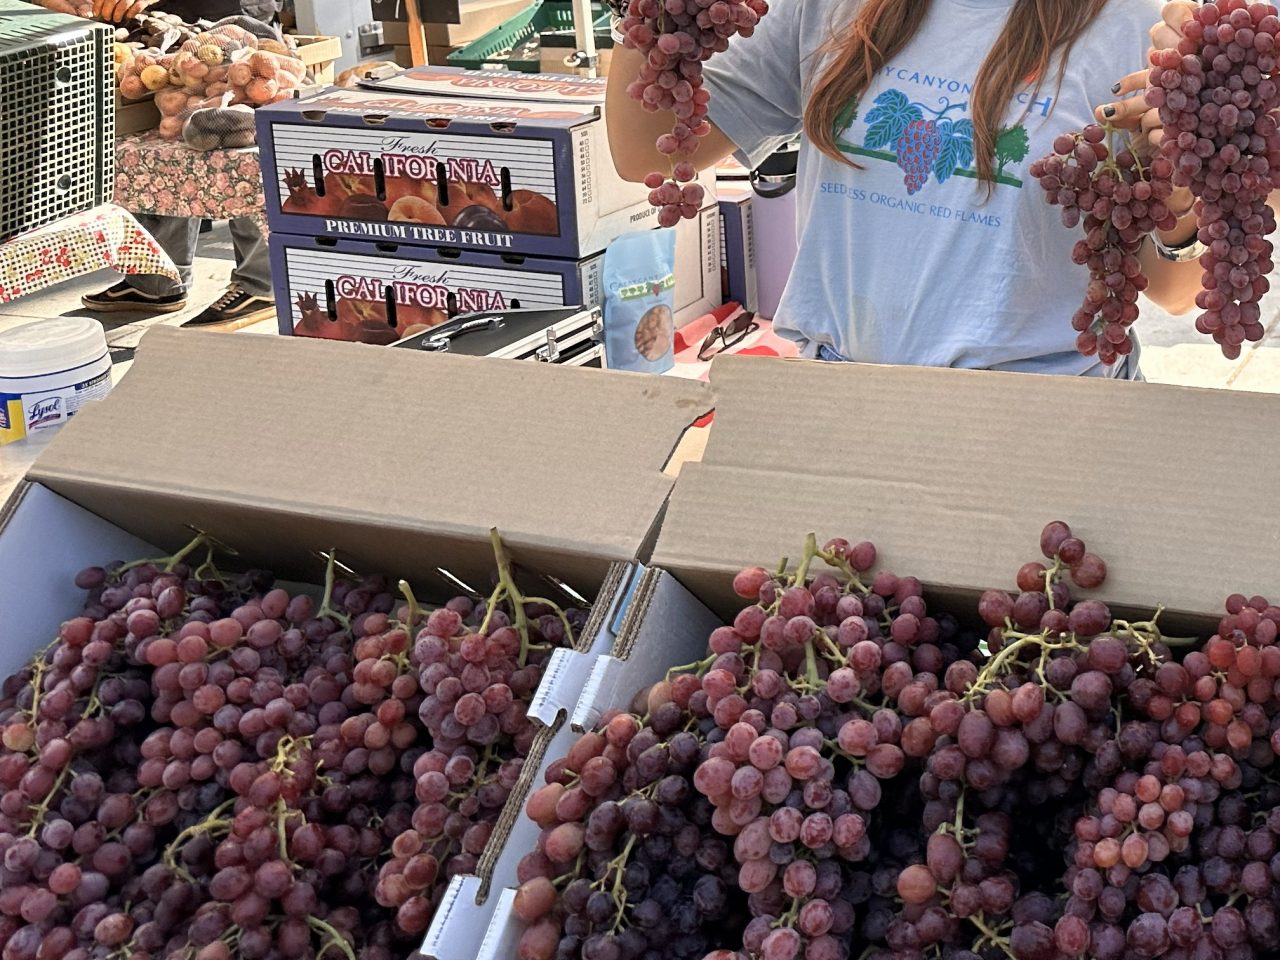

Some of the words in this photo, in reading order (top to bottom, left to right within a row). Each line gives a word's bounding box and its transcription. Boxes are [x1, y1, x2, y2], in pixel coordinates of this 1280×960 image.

[381, 136, 439, 155] Fresh
[324, 149, 501, 187] CALIFORNIA
[869, 193, 927, 215] ORGANIC
[929, 204, 953, 219] RED
[955, 209, 1001, 228] FLAMES
[325, 219, 407, 239] PREMIUM
[409, 226, 457, 242] TREE
[460, 231, 514, 248] FRUIT
[393, 264, 450, 284] Fresh
[336, 274, 508, 314] CALIFORNIA
[28, 398, 60, 421] Lysol
